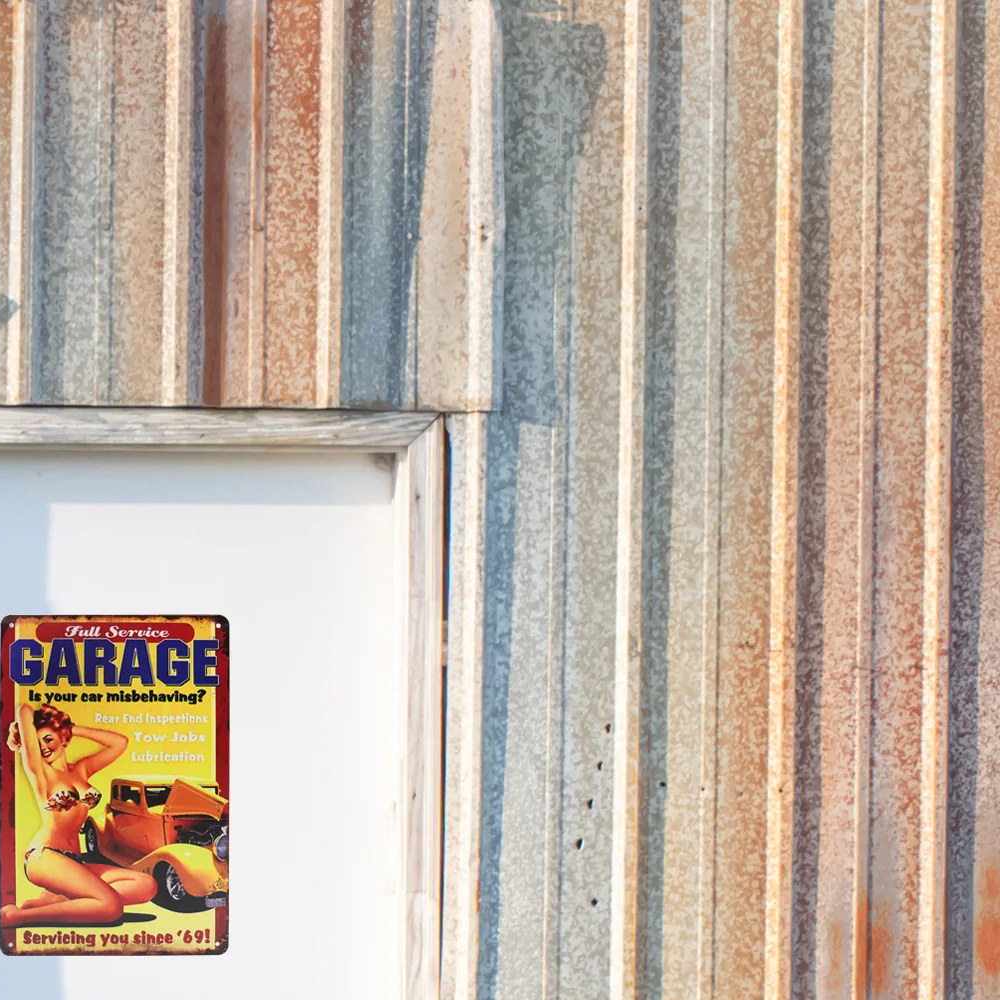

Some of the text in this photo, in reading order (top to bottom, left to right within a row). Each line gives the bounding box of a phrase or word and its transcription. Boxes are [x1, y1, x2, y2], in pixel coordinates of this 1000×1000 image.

[64, 625, 170, 638] Full Service
[9, 638, 220, 687] GARAGE
[29, 689, 207, 704] Is your car misbehaving?
[95, 712, 208, 725] Rear End Inspections
[133, 731, 206, 743] Tow Jobs
[131, 751, 205, 762] Lubrication
[23, 928, 211, 947] Servicing you since '69!
